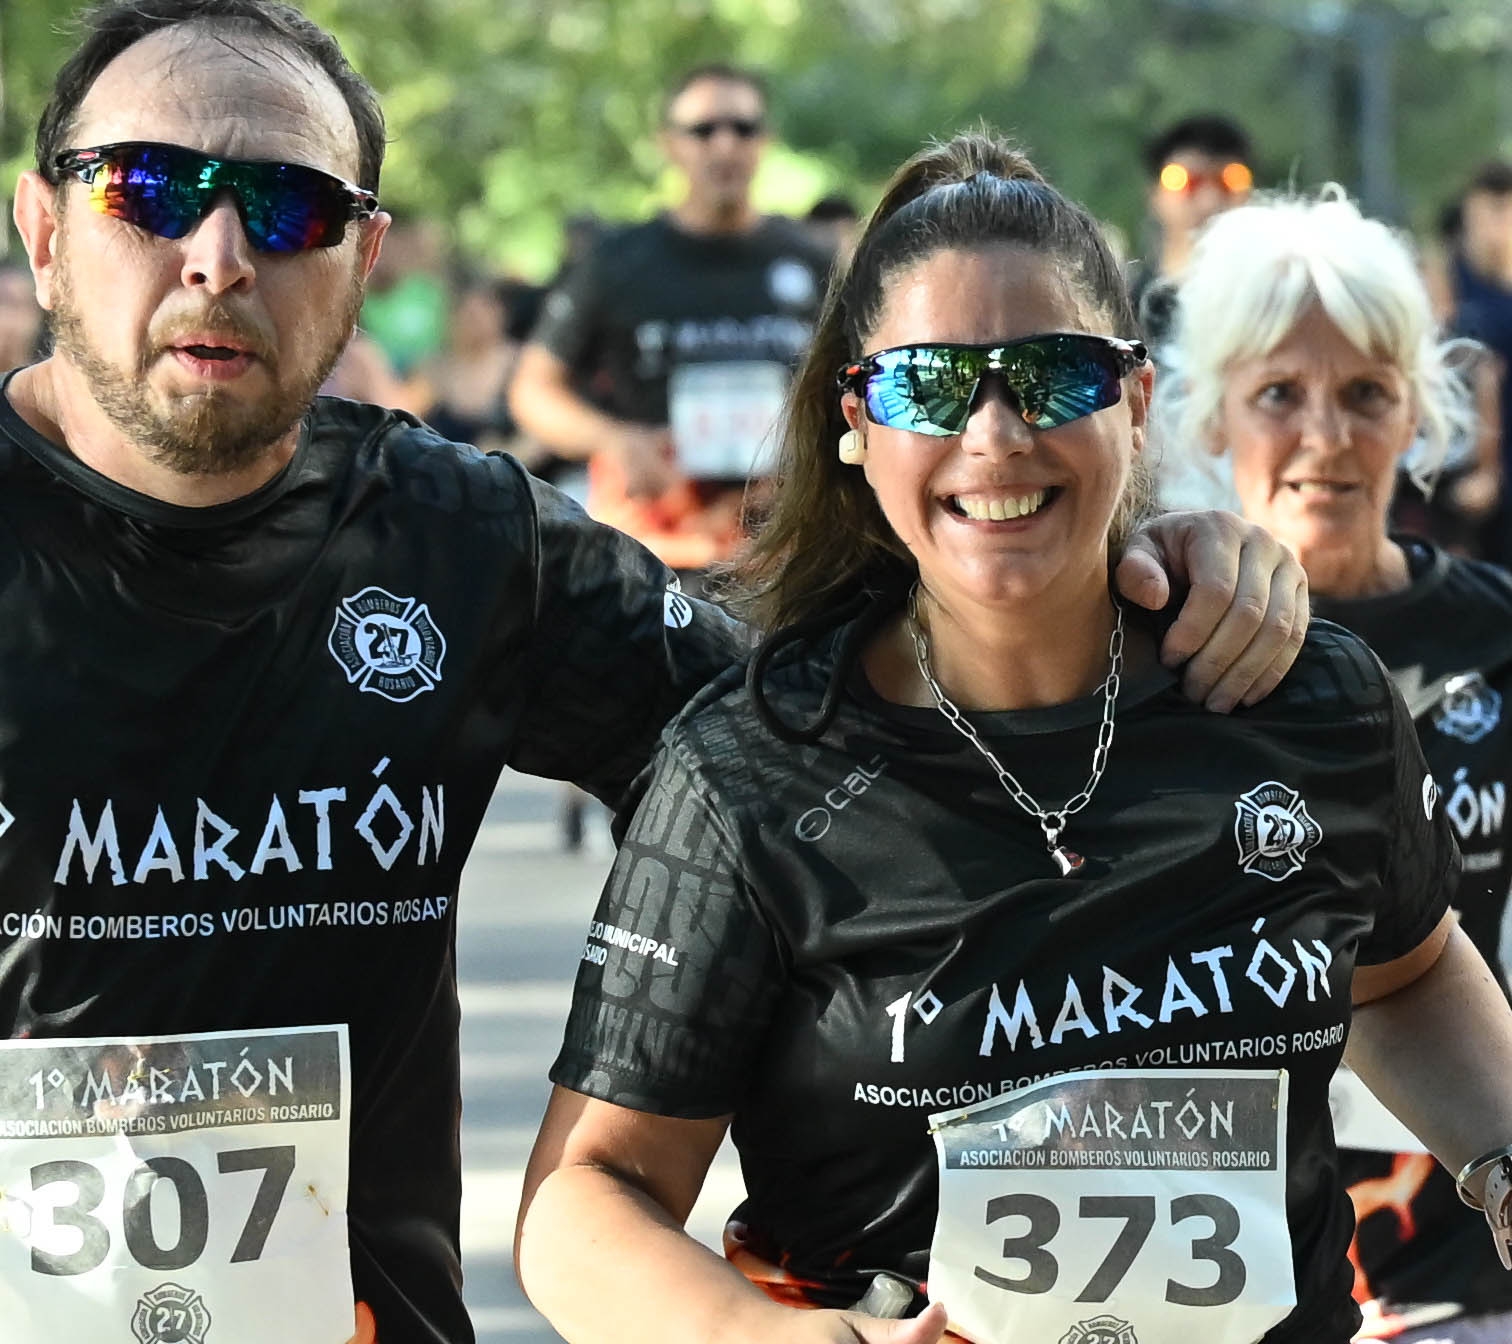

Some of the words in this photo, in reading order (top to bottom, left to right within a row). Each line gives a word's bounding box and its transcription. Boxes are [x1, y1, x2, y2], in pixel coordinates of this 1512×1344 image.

[363, 622, 409, 660] 27
[53, 755, 445, 886] MARATÓN
[1262, 813, 1296, 847] 27
[69, 913, 214, 940] BOMBEROS
[221, 900, 389, 934] VOLUNTARIOS
[885, 988, 944, 1064] 1°
[978, 917, 1334, 1058] MARATÓN
[28, 1067, 65, 1110] 1°
[80, 1045, 295, 1108] MARATÓN
[853, 1080, 992, 1108] ASOCIACIÓN
[1134, 1034, 1287, 1068] VOLUNTARIOS
[1291, 1022, 1344, 1053] ROSARIO
[87, 1115, 166, 1135] BOMBEROS
[169, 1106, 266, 1131] VOLUNTARIOS
[270, 1103, 334, 1121] ROSARIO
[1044, 1087, 1235, 1140] MARATÓN
[1050, 1149, 1122, 1167] BOMBEROS
[1123, 1149, 1209, 1168] VOLUNTARIOS
[1212, 1149, 1271, 1168] ROSARIO
[29, 1144, 297, 1277] 307
[973, 1193, 1247, 1307] 373
[155, 1306, 187, 1334] 27
